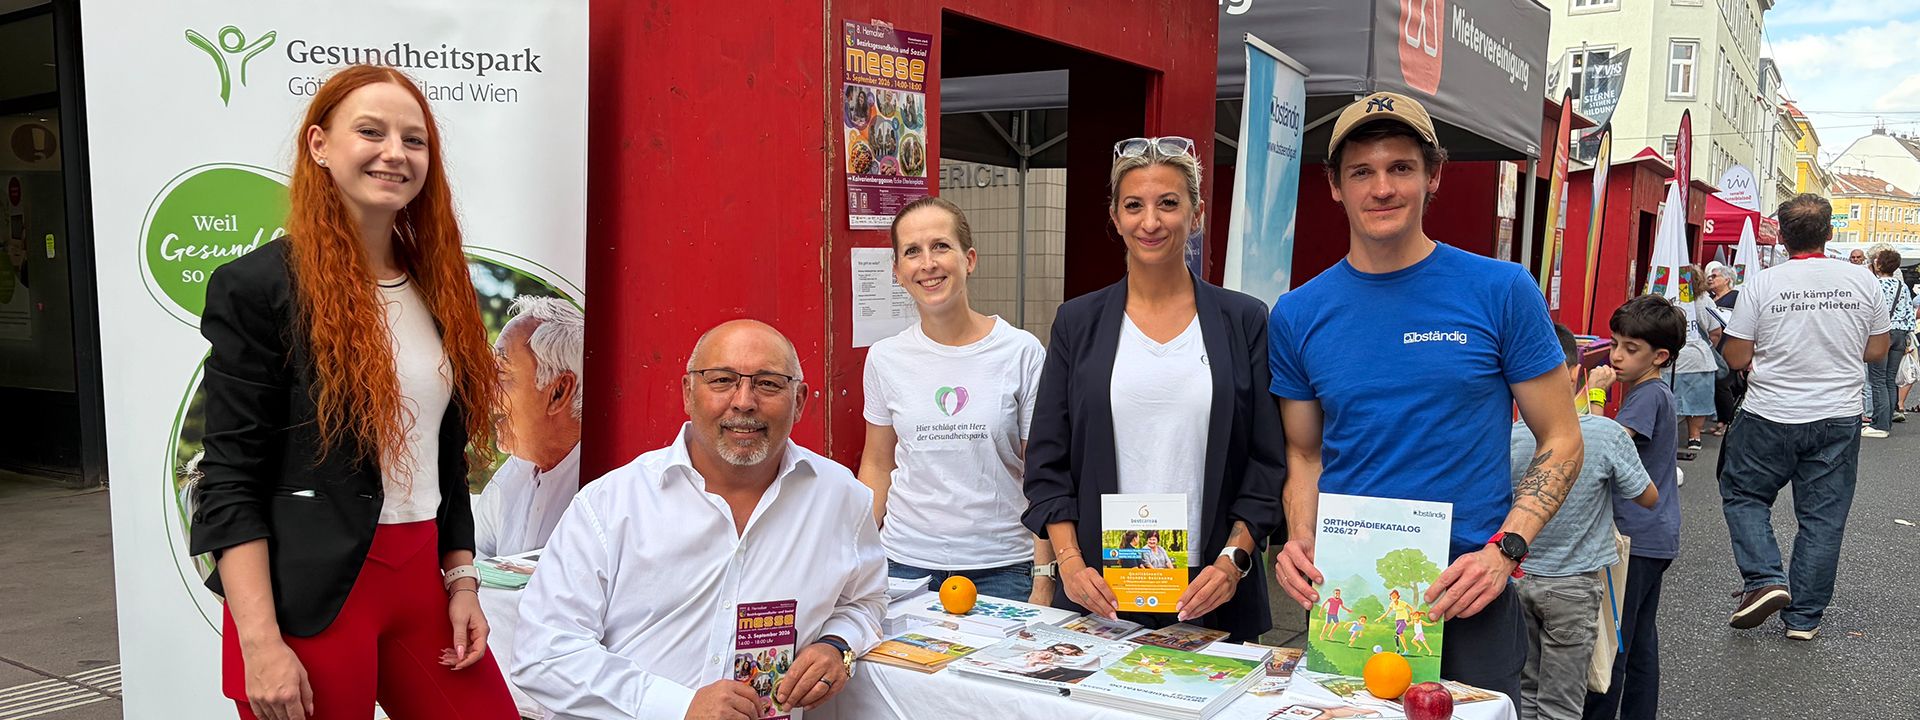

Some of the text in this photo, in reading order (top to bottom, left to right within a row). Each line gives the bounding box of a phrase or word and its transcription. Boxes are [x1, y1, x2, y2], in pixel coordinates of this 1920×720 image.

[910, 47, 927, 57] Sozial
[1452, 4, 1529, 92] Mietervereinigung
[286, 40, 542, 77] Gesundheitspark
[846, 47, 926, 83] messe
[1605, 62, 1622, 76] VHS
[852, 75, 877, 85] September
[419, 80, 463, 101] iland
[470, 83, 518, 102] Wien
[1583, 89, 1615, 104] STERNE
[1589, 98, 1611, 109] STEHEN
[192, 214, 239, 232] Weil
[182, 269, 205, 284] so
[1780, 288, 1852, 301] Wir kämpfen
[1771, 301, 1860, 314] für faire Mieten!
[916, 424, 930, 432] Hier
[932, 423, 956, 432] schlägt
[969, 423, 986, 431] Herz
[917, 432, 989, 441] der Gesundheitsparks
[1322, 526, 1359, 537] 2026/27
[1323, 517, 1421, 534] ORTHOPÄDIEKATALOG
[739, 614, 794, 629] messe
